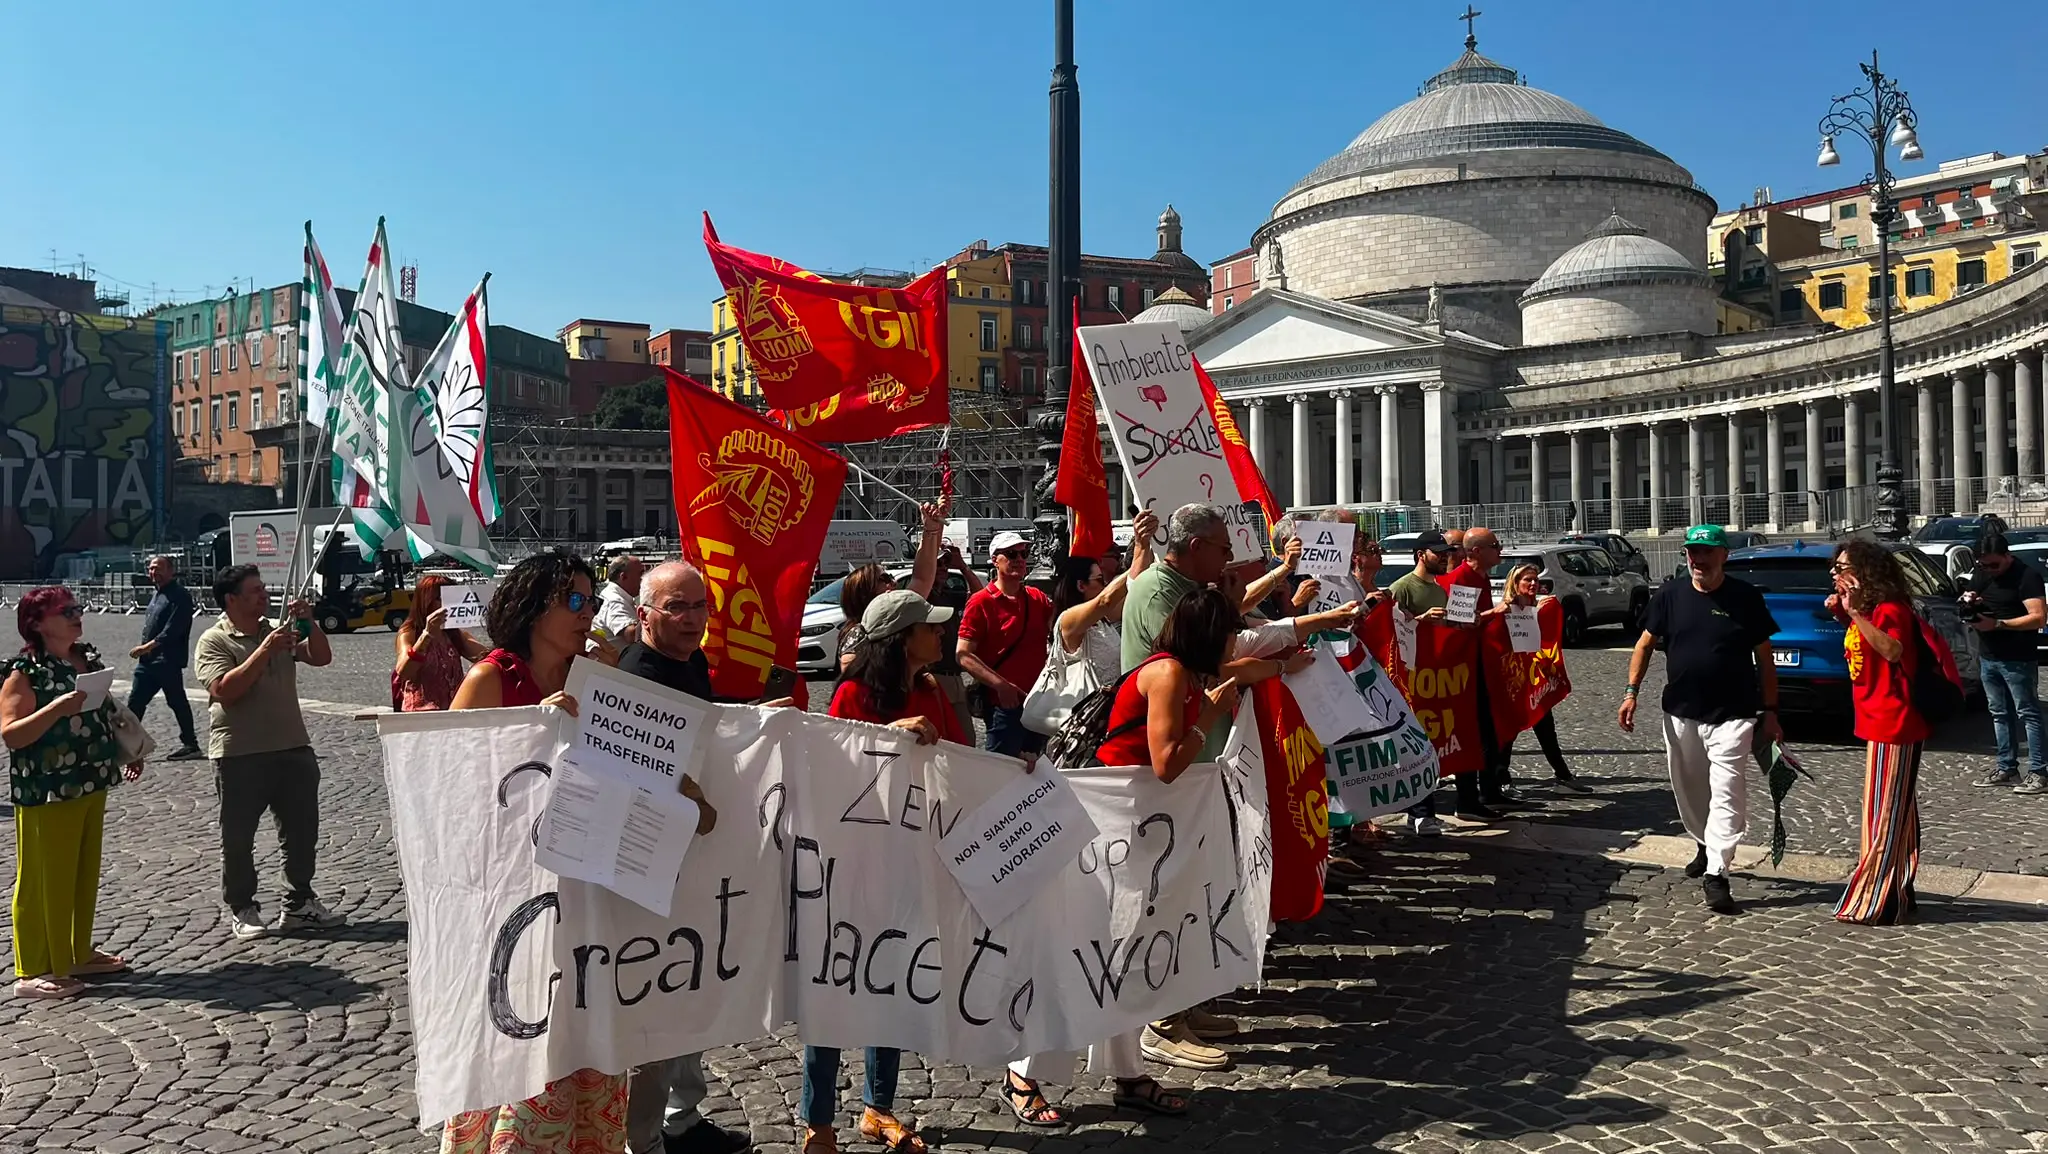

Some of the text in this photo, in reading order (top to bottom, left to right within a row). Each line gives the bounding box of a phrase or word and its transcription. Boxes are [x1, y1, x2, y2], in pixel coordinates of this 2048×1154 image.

[760, 333, 806, 360] FIOM
[1093, 333, 1192, 387] Ambiente
[1125, 415, 1220, 467] Sociale
[757, 484, 788, 541] FIOM
[1300, 547, 1342, 564] ZENITA
[590, 712, 676, 754] PACCHI DA
[592, 689, 687, 731] NON SIAMO
[584, 731, 676, 777] TRASFERIRE
[1342, 769, 1397, 788] FEDERAZIONE
[954, 779, 1056, 866] NON SIAMO PACCHI
[998, 821, 1033, 853] SIAMO
[991, 820, 1063, 884] LAVORATORI
[487, 876, 750, 1040] Great
[784, 834, 942, 1006] Place
